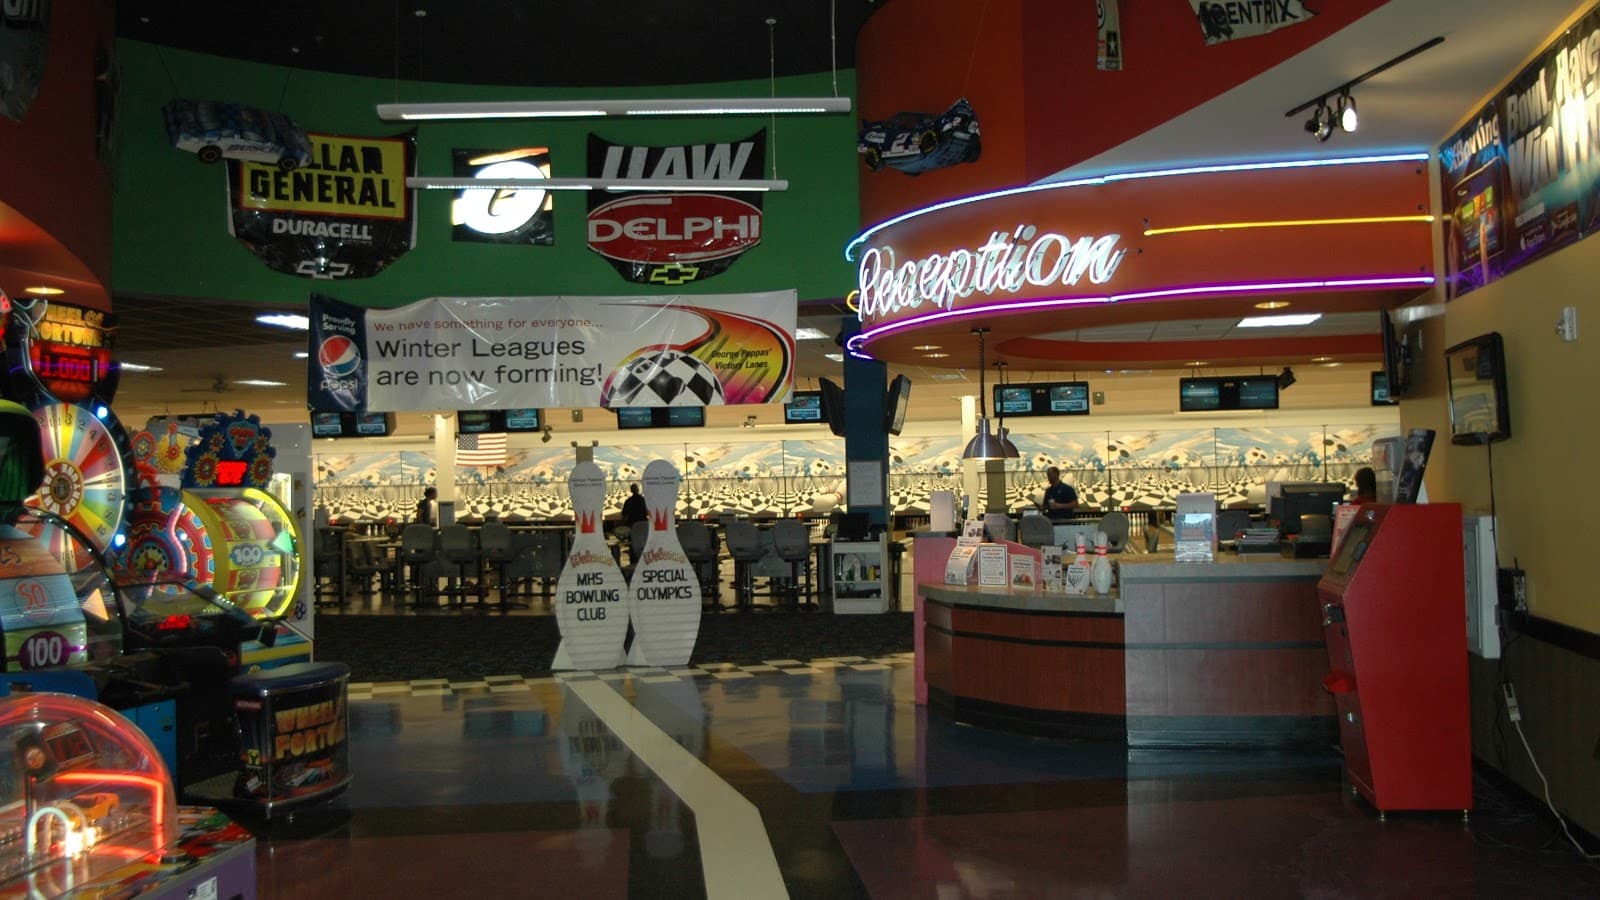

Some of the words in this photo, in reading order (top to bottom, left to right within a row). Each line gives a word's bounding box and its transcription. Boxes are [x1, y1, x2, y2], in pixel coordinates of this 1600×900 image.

[891, 133, 910, 153] 2
[600, 142, 754, 186] UAW
[250, 169, 396, 208] GENERAL
[272, 218, 372, 240] DURACELL
[588, 215, 760, 242] DELPHI
[859, 224, 1126, 322] Reception
[322, 313, 356, 327] Proudly
[322, 321, 356, 335] Serving
[374, 322, 394, 332] We
[399, 320, 431, 331] have
[434, 318, 503, 331] something
[508, 317, 528, 329] for
[531, 317, 603, 330] everyone...
[375, 339, 461, 358] Winter
[472, 338, 585, 361] Leagues
[745, 360, 768, 369] Lanes
[376, 369, 419, 386] are
[428, 367, 485, 386] now
[495, 363, 603, 385] forming!
[235, 545, 263, 563] 100
[577, 572, 603, 586] MHS
[643, 569, 688, 583] SPECIAL
[566, 589, 620, 604] BOWLING
[637, 586, 692, 600] OLYMPICS
[577, 607, 606, 621] CLUB
[27, 636, 63, 667] 100
